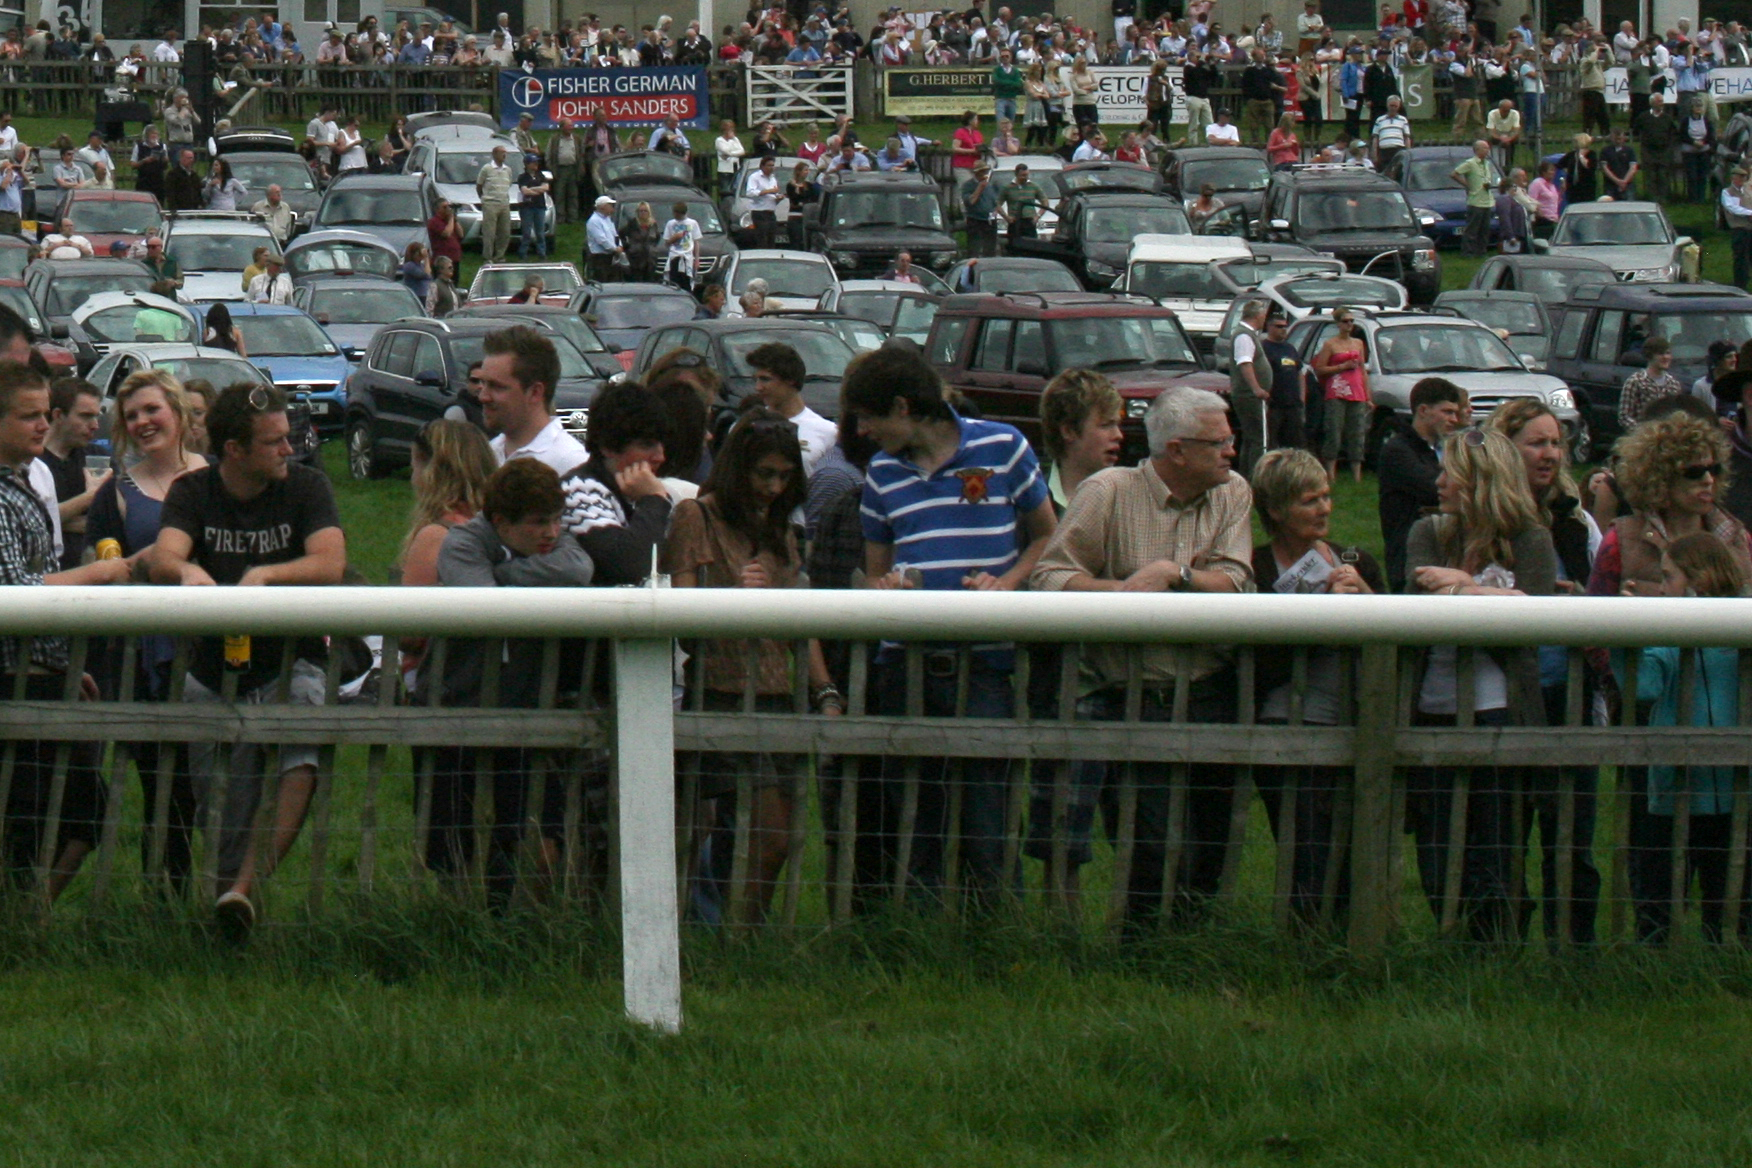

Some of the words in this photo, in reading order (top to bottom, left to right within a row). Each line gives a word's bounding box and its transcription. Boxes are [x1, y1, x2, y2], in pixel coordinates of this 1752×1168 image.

[548, 77, 610, 94] FISHER
[614, 75, 696, 93] GERMAN
[556, 99, 604, 119] JOHN
[610, 98, 689, 116] SANDERS
